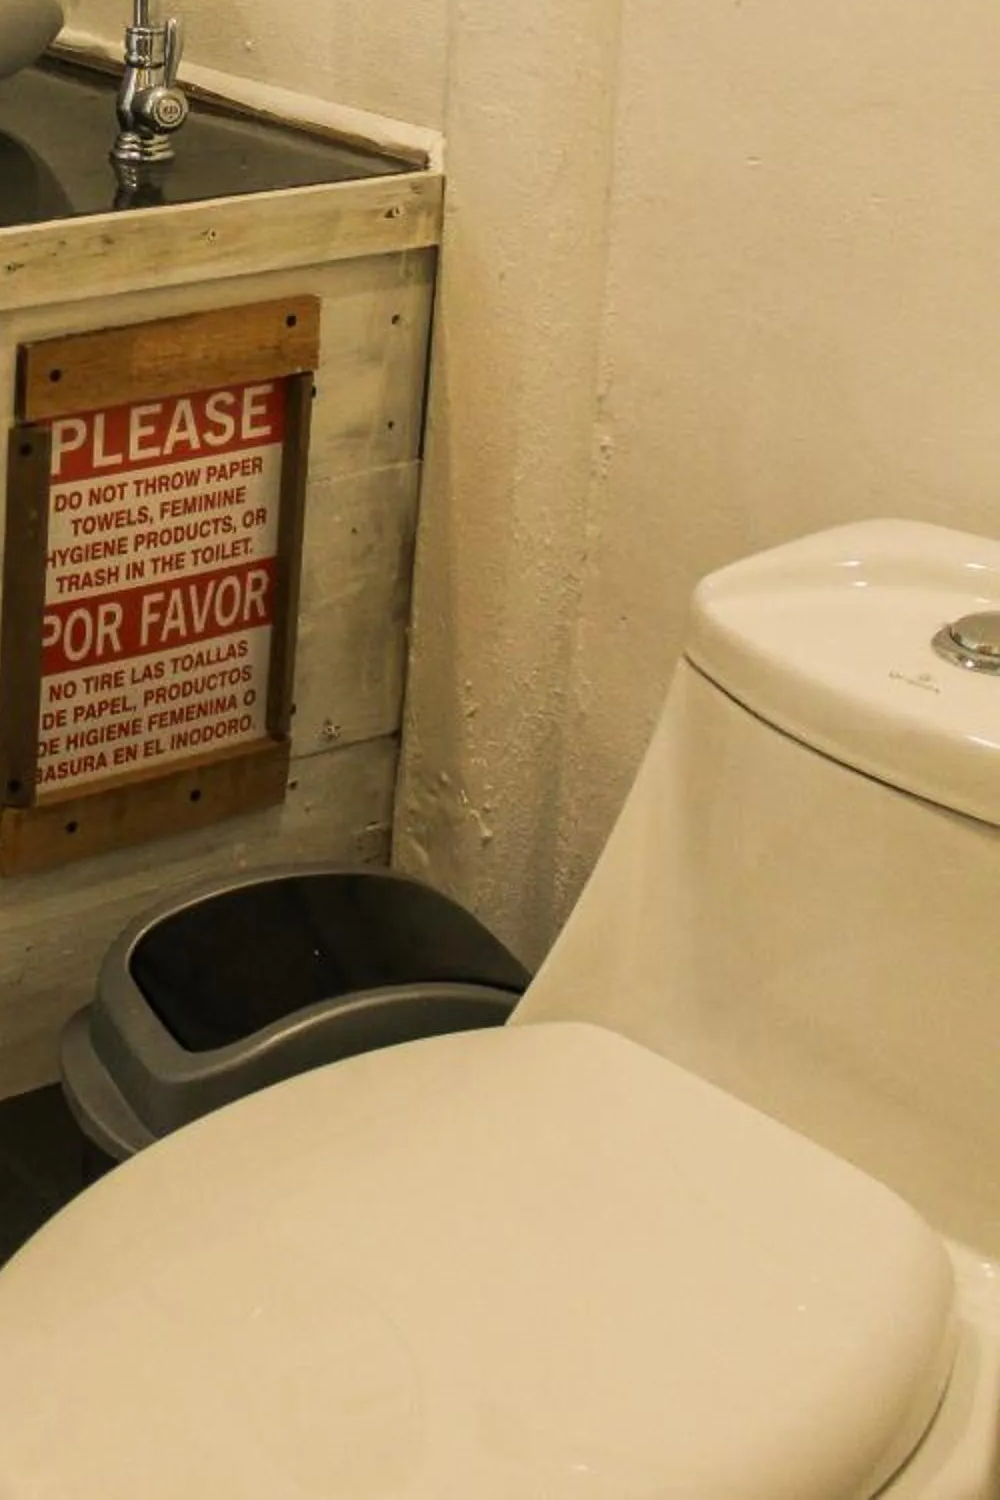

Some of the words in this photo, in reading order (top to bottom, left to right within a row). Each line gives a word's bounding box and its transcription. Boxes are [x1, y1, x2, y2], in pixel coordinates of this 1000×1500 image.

[51, 384, 275, 475] PLEASE
[54, 491, 82, 512] DO
[88, 483, 128, 506] NOT
[133, 471, 201, 497] THROW
[206, 456, 263, 484] PAPER
[71, 506, 153, 536] TOWELS,
[160, 486, 246, 519] FEMININE
[134, 515, 237, 552] PRODUCTS,
[242, 507, 267, 528] OR
[56, 566, 119, 594] TRASH
[125, 560, 144, 580] IN
[151, 551, 185, 574] THE
[191, 537, 254, 566] TOILET.
[42, 602, 123, 662] POR
[140, 568, 270, 646] FAVOR
[42, 709, 67, 731] DE
[73, 694, 137, 724] PAPEL,
[143, 664, 252, 706] PRODUCTOS
[50, 680, 76, 702] NO
[83, 670, 125, 696] TIRE
[131, 661, 165, 685] LAS
[171, 639, 249, 674] TOALLAS
[66, 718, 142, 751] HIGIENE
[148, 694, 238, 732] FEMENINA
[243, 689, 256, 706] O
[114, 743, 137, 765] EN
[143, 737, 164, 757] EL
